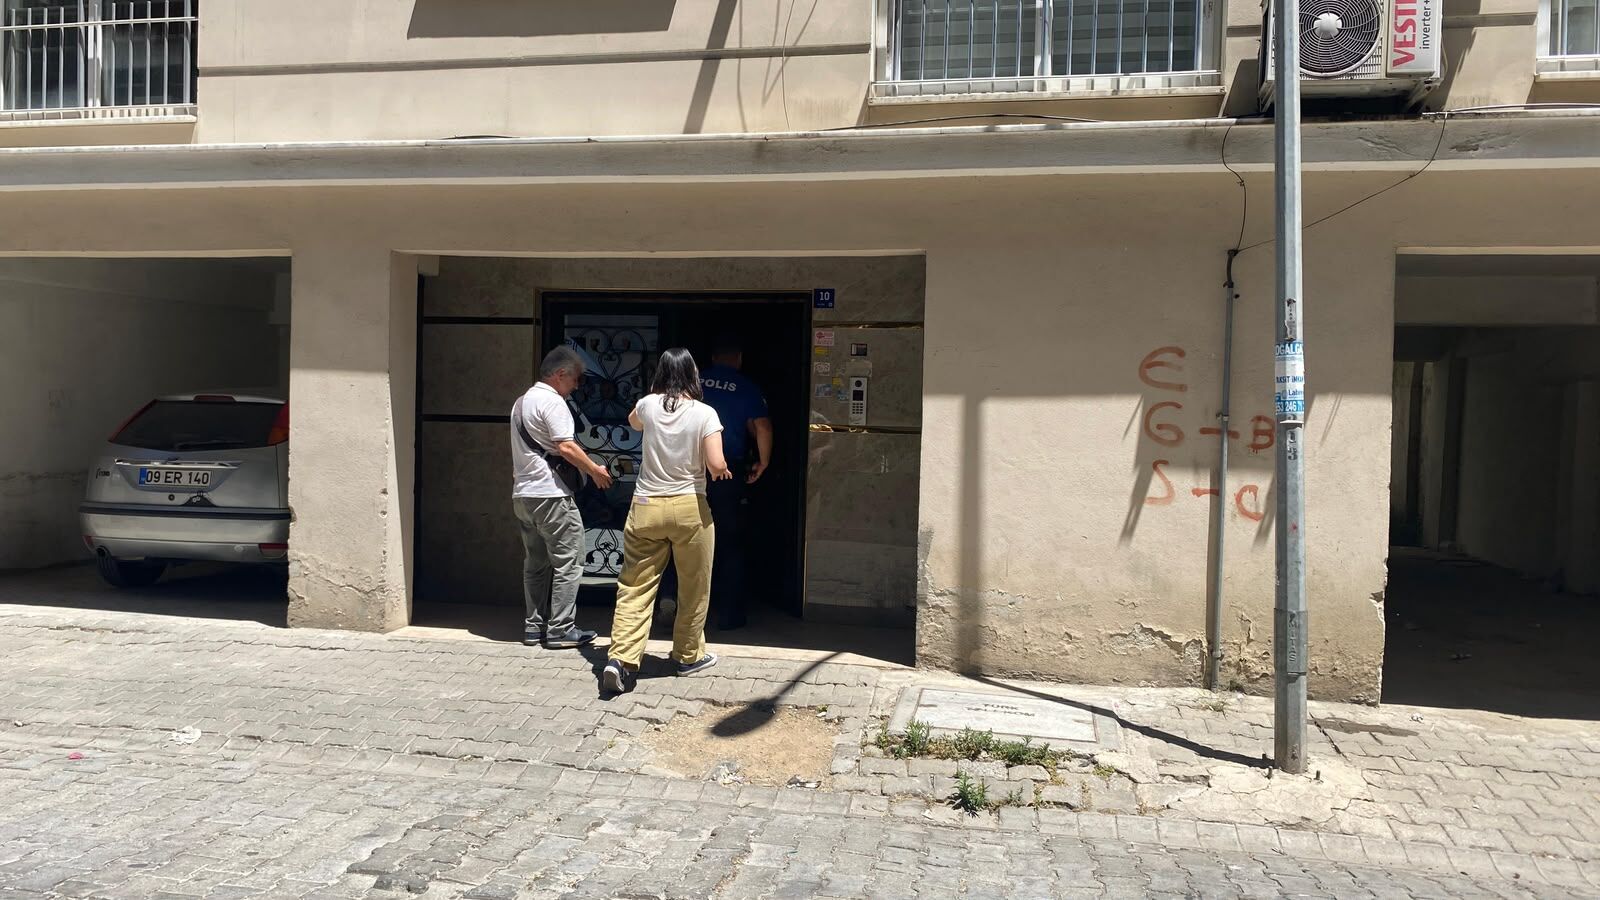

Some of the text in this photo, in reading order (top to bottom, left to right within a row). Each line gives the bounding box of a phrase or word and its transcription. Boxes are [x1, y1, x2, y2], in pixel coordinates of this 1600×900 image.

[1392, 0, 1417, 67] VEST
[819, 291, 830, 301] 10
[145, 470, 210, 485] 09 ER 140
